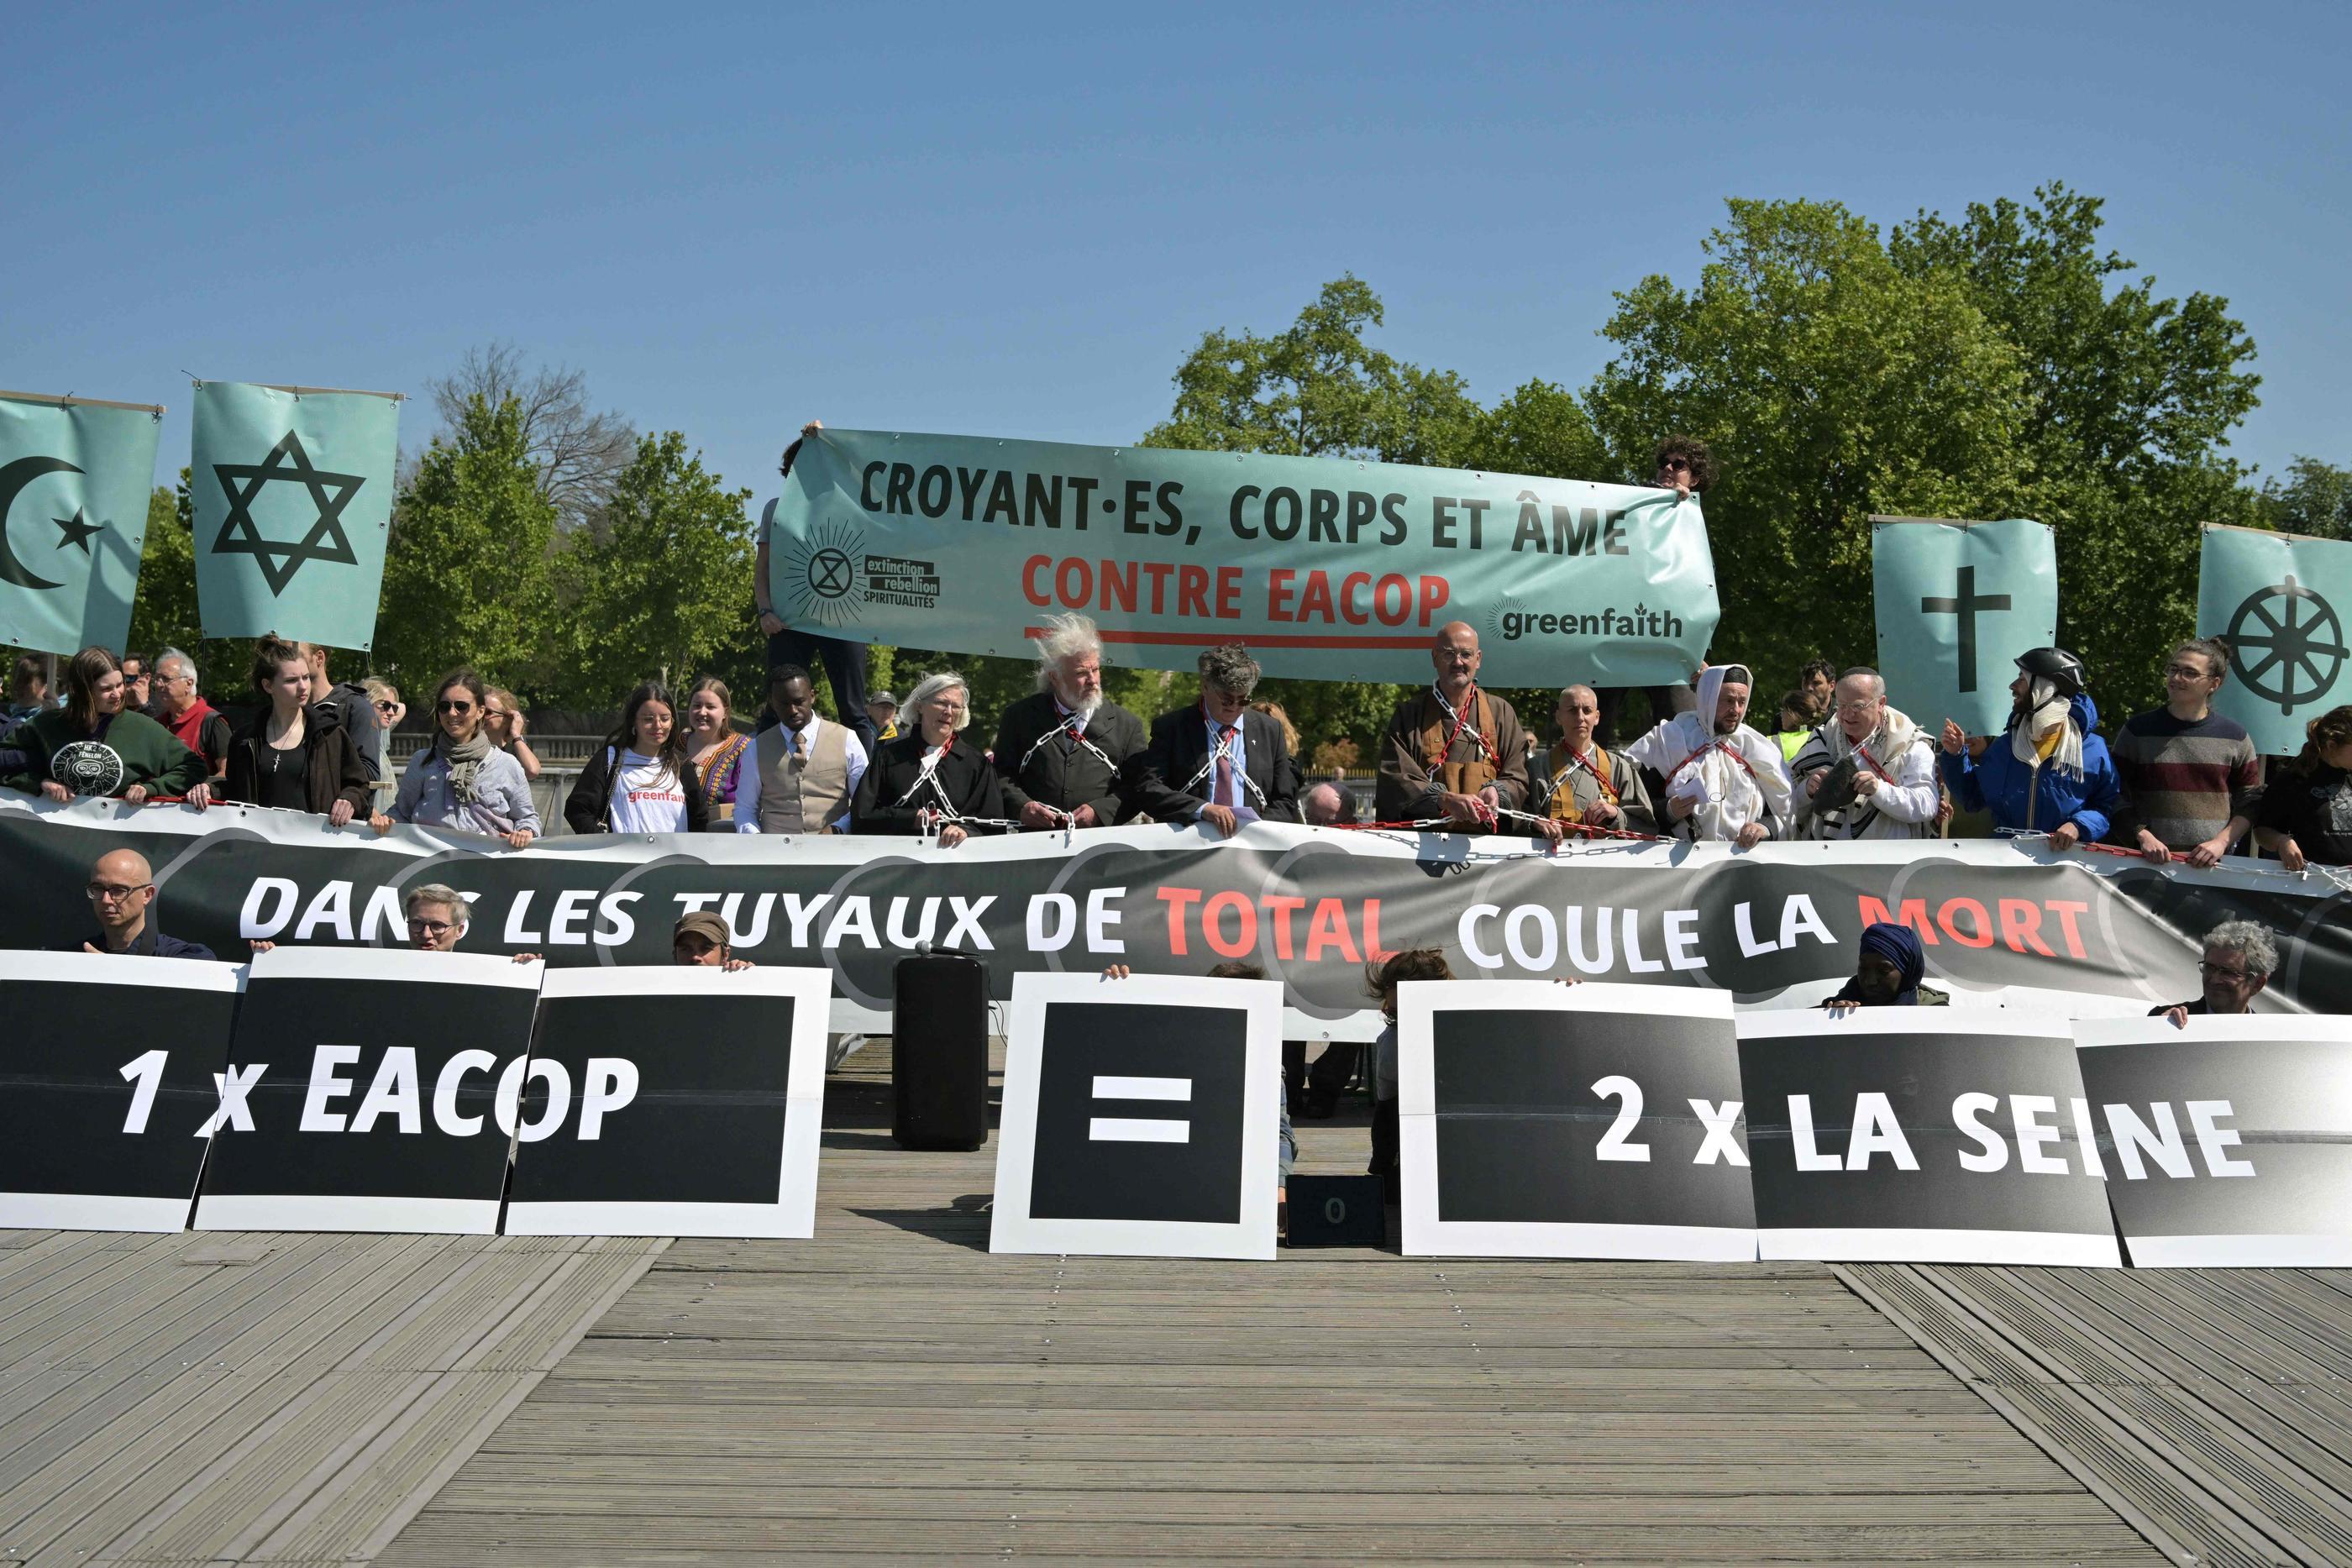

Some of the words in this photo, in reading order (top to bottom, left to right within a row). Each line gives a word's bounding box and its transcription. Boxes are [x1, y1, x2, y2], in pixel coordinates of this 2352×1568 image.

[1229, 485, 1408, 547] CORPS
[1432, 496, 1491, 550] ET
[1511, 490, 1630, 557] ÂME
[864, 590, 934, 609] SPIRITUALITÉS
[867, 559, 925, 576] extinction
[885, 576, 937, 594] rebellion
[1021, 554, 1243, 620] CONTRE
[1268, 568, 1451, 627] EACOP
[1502, 601, 1683, 640] greenfaith
[504, 889, 644, 947] LES
[1026, 886, 1126, 954] DE
[1156, 886, 1401, 963] TOTAL
[1457, 903, 1709, 974] COULE
[1734, 894, 1839, 958] LA
[1858, 894, 2088, 960] MORT
[118, 1049, 169, 1134] 1
[299, 1044, 640, 1143] EACOP
[1590, 1075, 1651, 1162] 2
[1787, 1092, 1921, 1172] LA
[1951, 1092, 2256, 1181] SEINE
